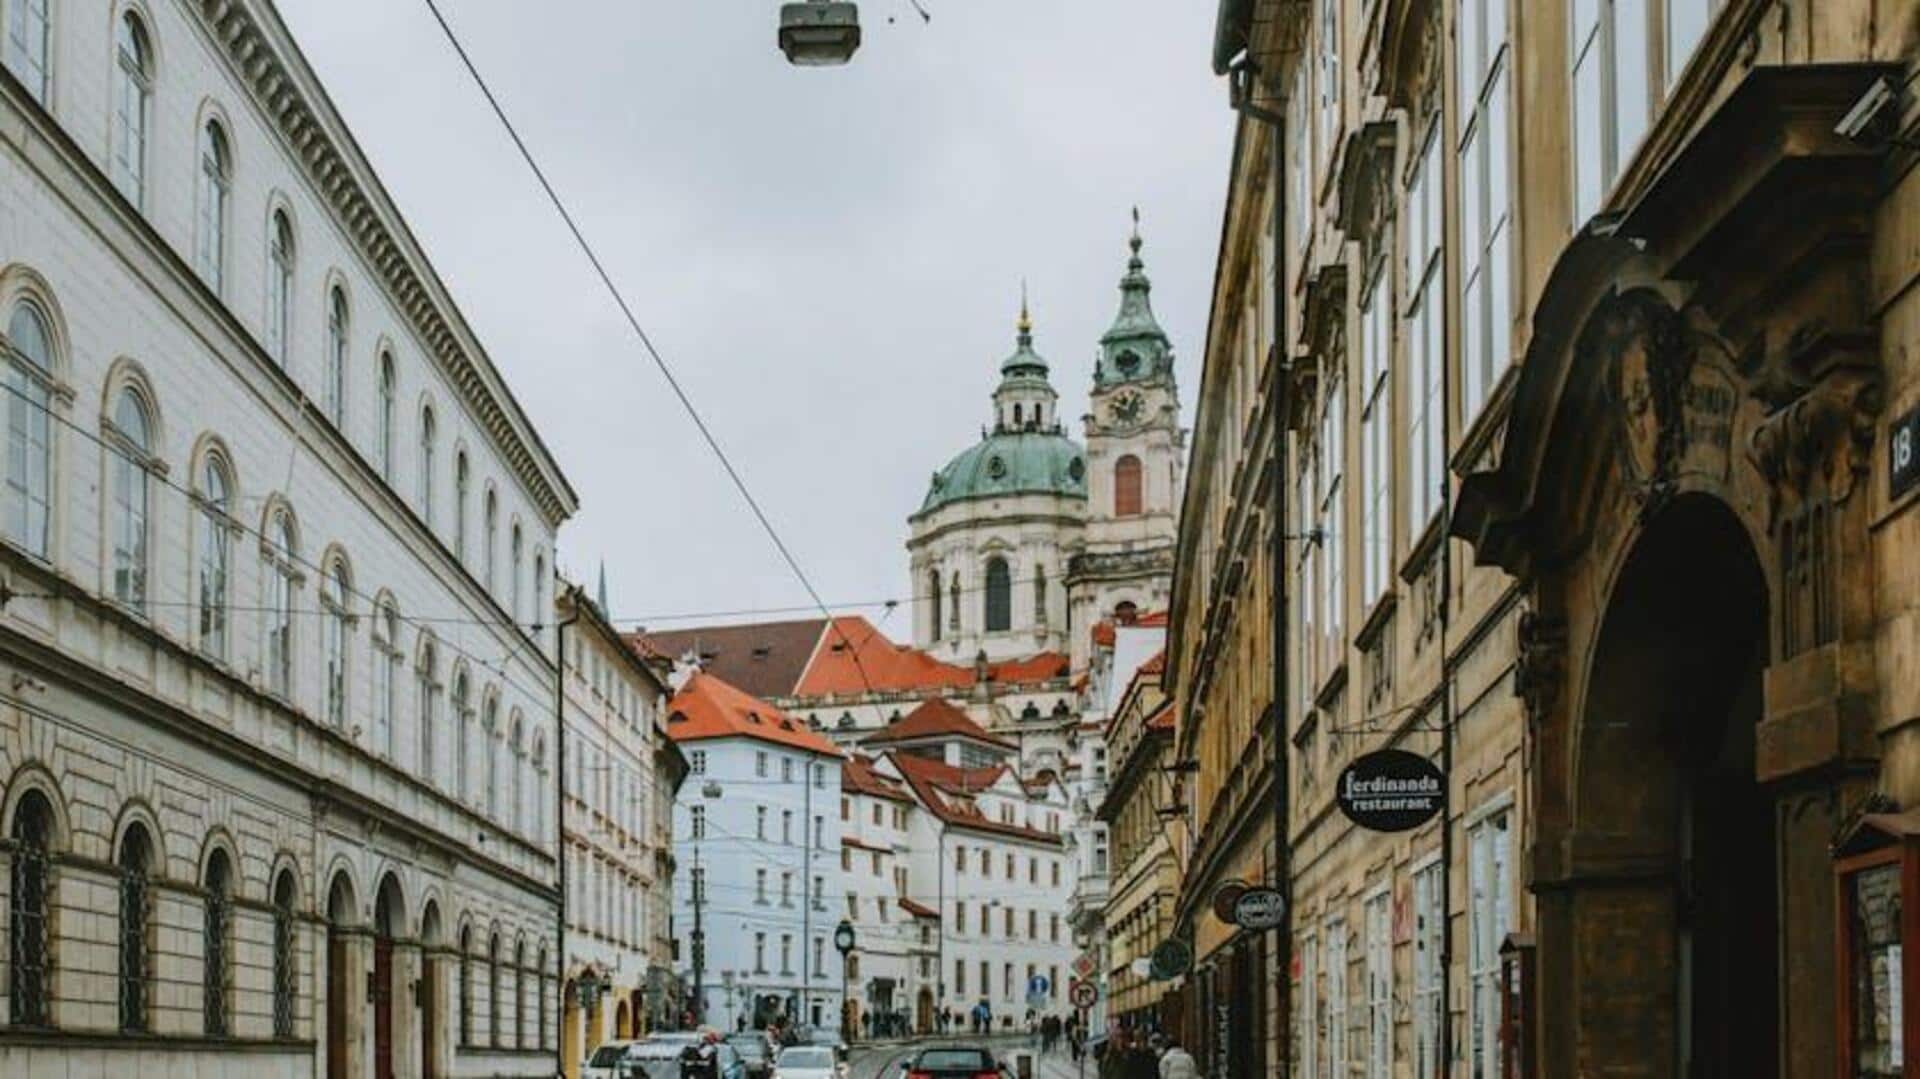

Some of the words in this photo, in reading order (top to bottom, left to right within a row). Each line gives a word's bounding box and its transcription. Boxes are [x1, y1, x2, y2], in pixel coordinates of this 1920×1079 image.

[1893, 426, 1912, 473] 18
[1346, 770, 1439, 799] ferdinanda
[1352, 797, 1432, 811] restaurant
